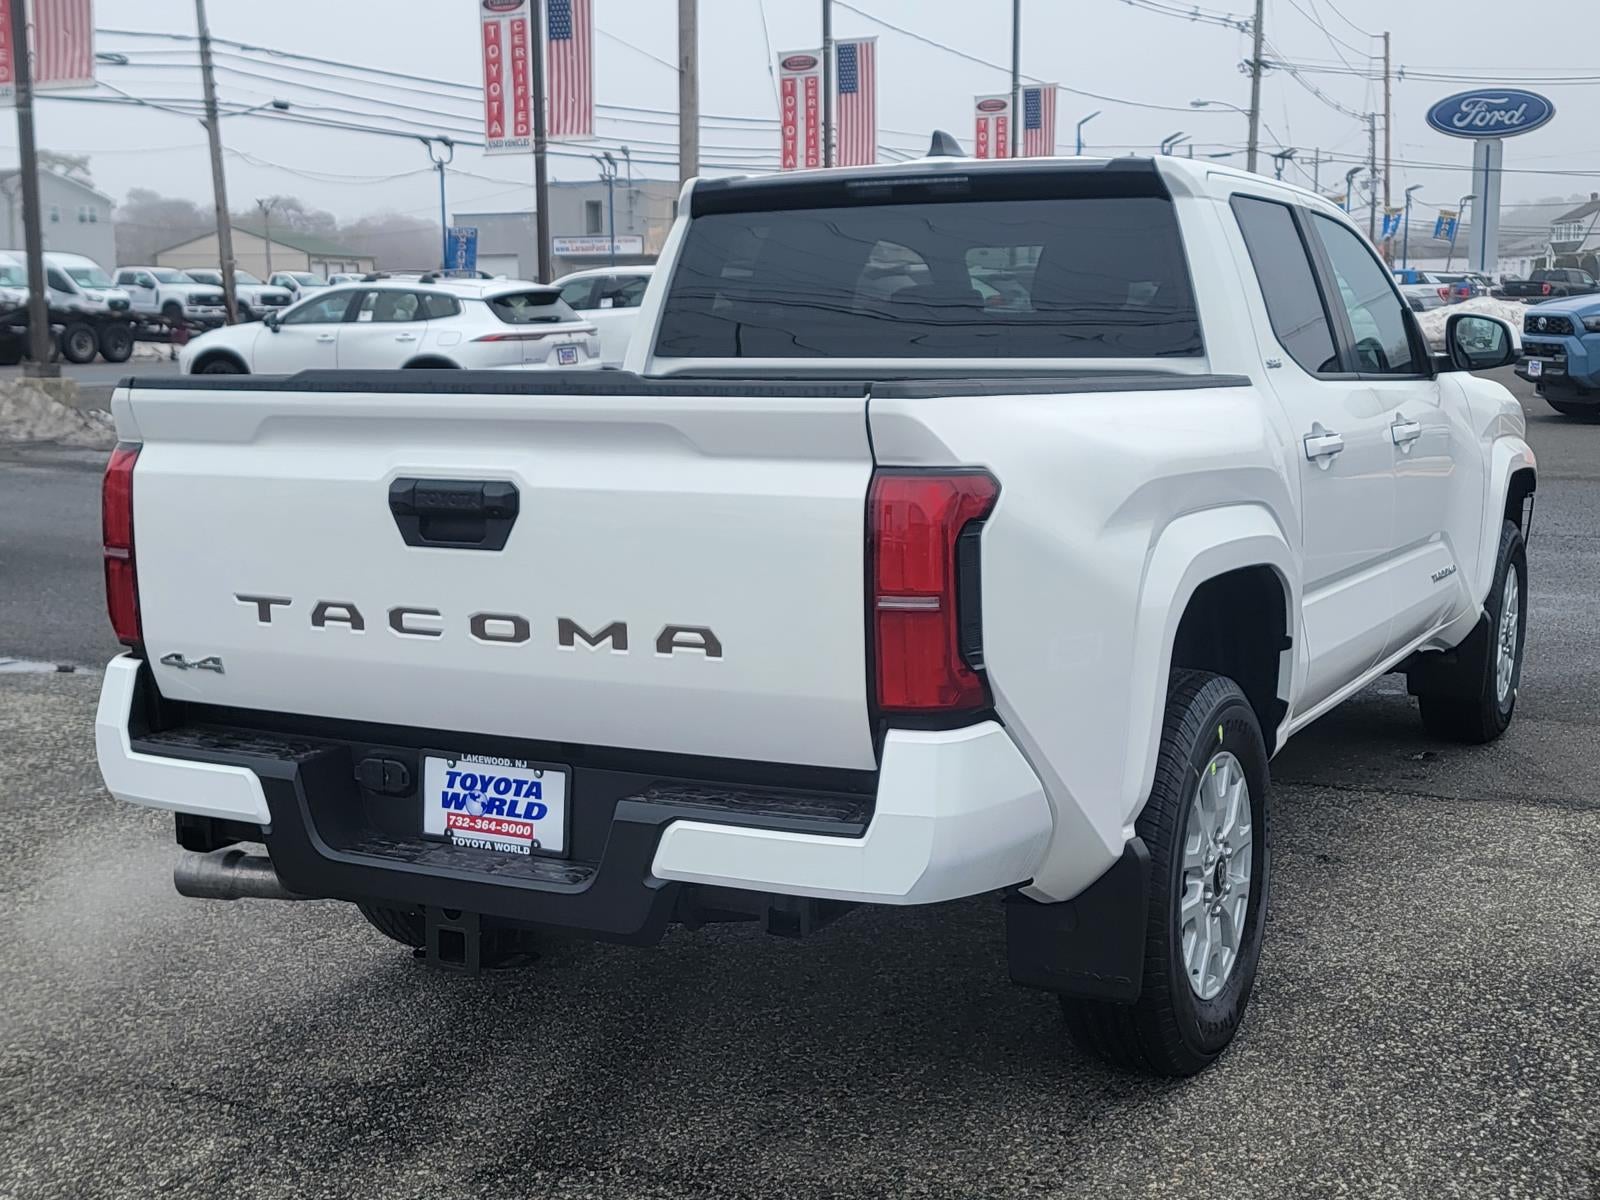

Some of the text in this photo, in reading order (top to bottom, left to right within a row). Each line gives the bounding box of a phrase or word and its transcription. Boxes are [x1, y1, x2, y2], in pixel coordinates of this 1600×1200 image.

[487, 24, 502, 134] TOYOTA
[513, 21, 527, 134] CERTIFIED
[783, 80, 796, 167] TOYOTA
[807, 78, 817, 165] CERTIFIED
[1453, 97, 1528, 128] Ford
[978, 119, 987, 158] TOY
[233, 592, 724, 661] TACOMA
[515, 759, 528, 769] NJ
[445, 770, 543, 800] TOYOTA
[449, 815, 531, 836] 732-364-9000
[452, 836, 531, 855] TOYOTA WORLD
